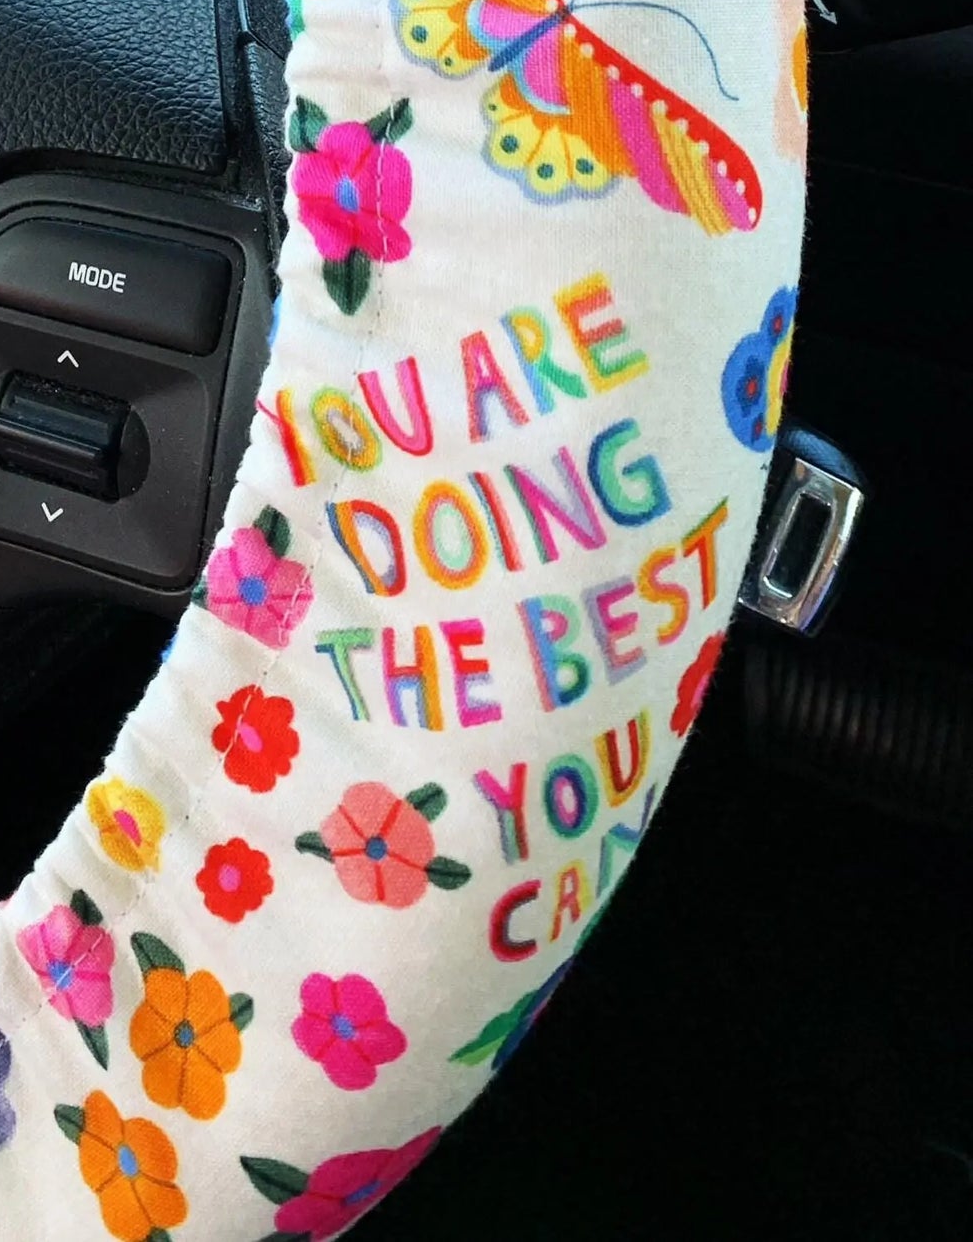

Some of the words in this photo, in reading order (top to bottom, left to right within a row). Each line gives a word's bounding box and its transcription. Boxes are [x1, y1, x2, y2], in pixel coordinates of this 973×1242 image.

[68, 260, 127, 294] MODE
[256, 356, 435, 488] YOU
[459, 270, 649, 444] ARE
[325, 417, 673, 596] DOING
[316, 619, 503, 731] THE
[516, 495, 729, 713] BEST
[472, 707, 654, 865] YOU
[488, 778, 660, 963] CAN
